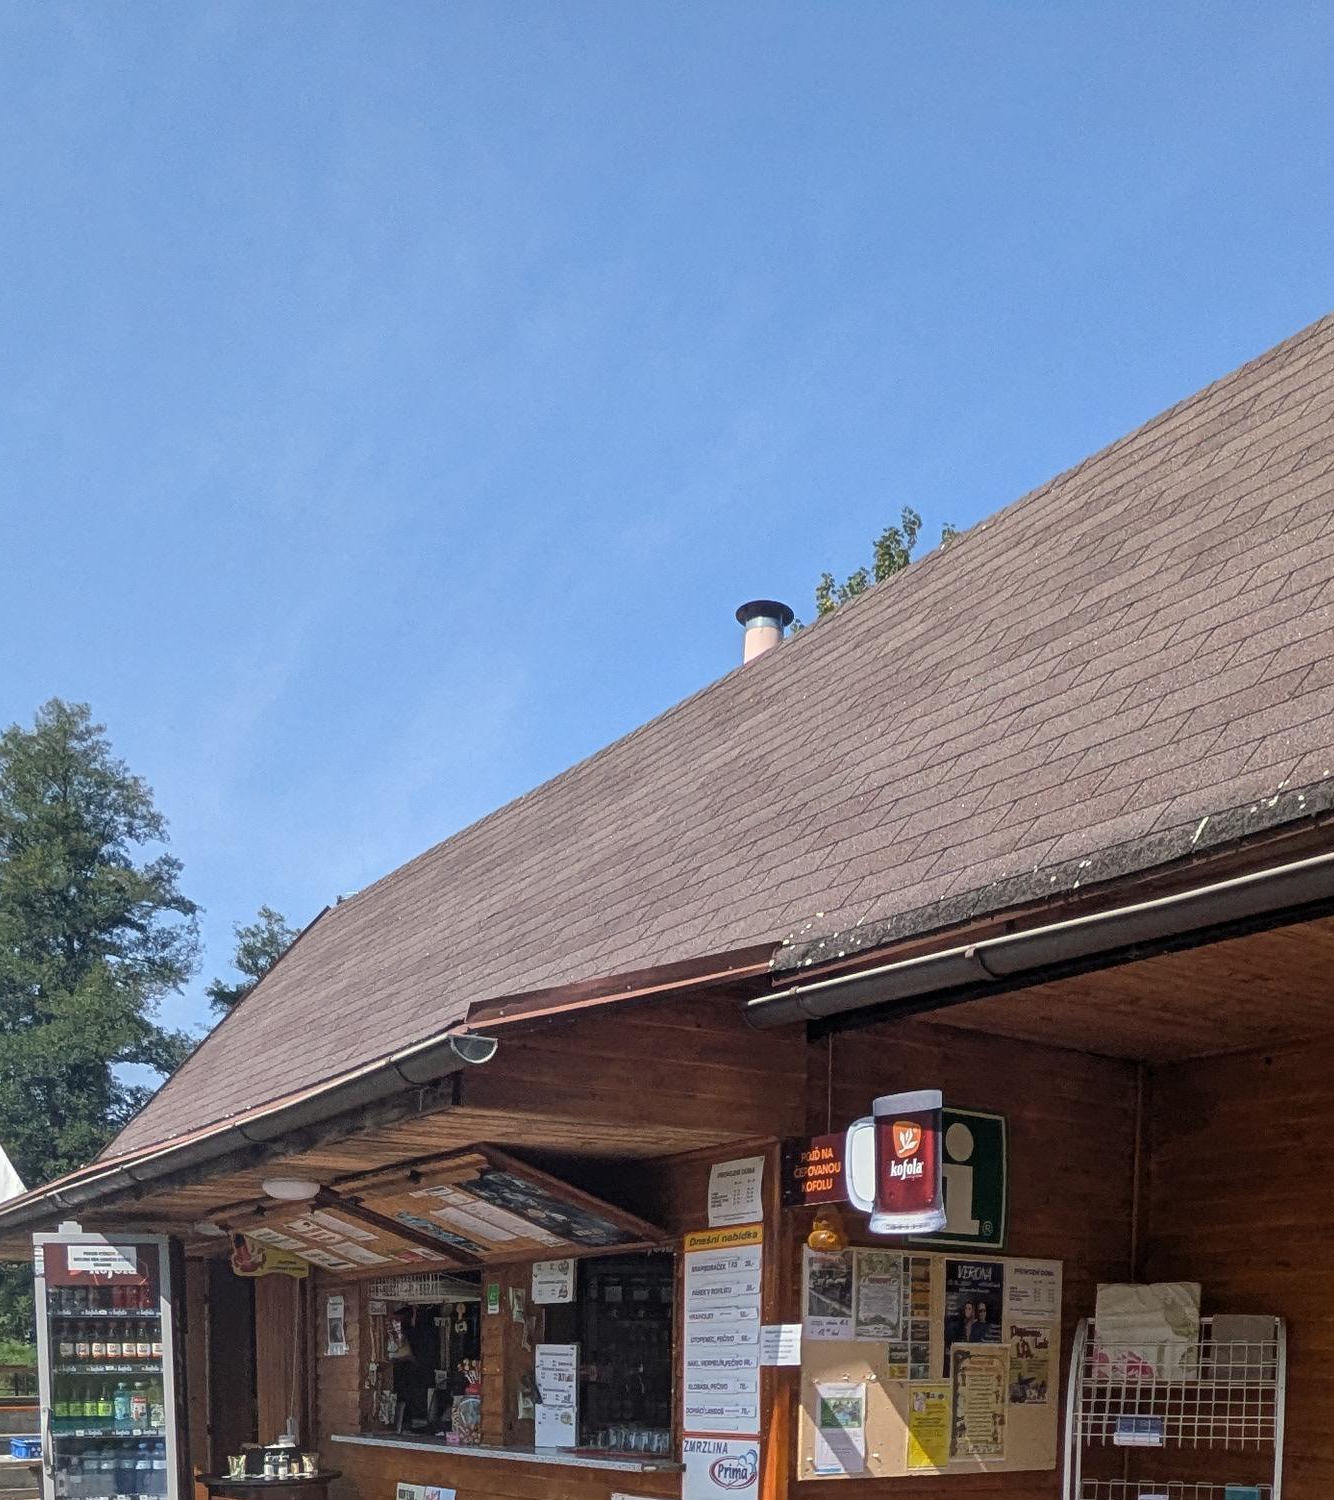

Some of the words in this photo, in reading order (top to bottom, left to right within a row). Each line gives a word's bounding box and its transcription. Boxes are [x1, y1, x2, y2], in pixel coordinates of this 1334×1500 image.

[821, 1147, 834, 1159] NA
[890, 1158, 923, 1181] kofola
[689, 1233, 720, 1247] Dnešní
[721, 1230, 758, 1243] nabídka
[957, 1264, 992, 1280] VERONA
[683, 1440, 728, 1455] ZMRZLINA
[718, 1463, 748, 1480] Prima
